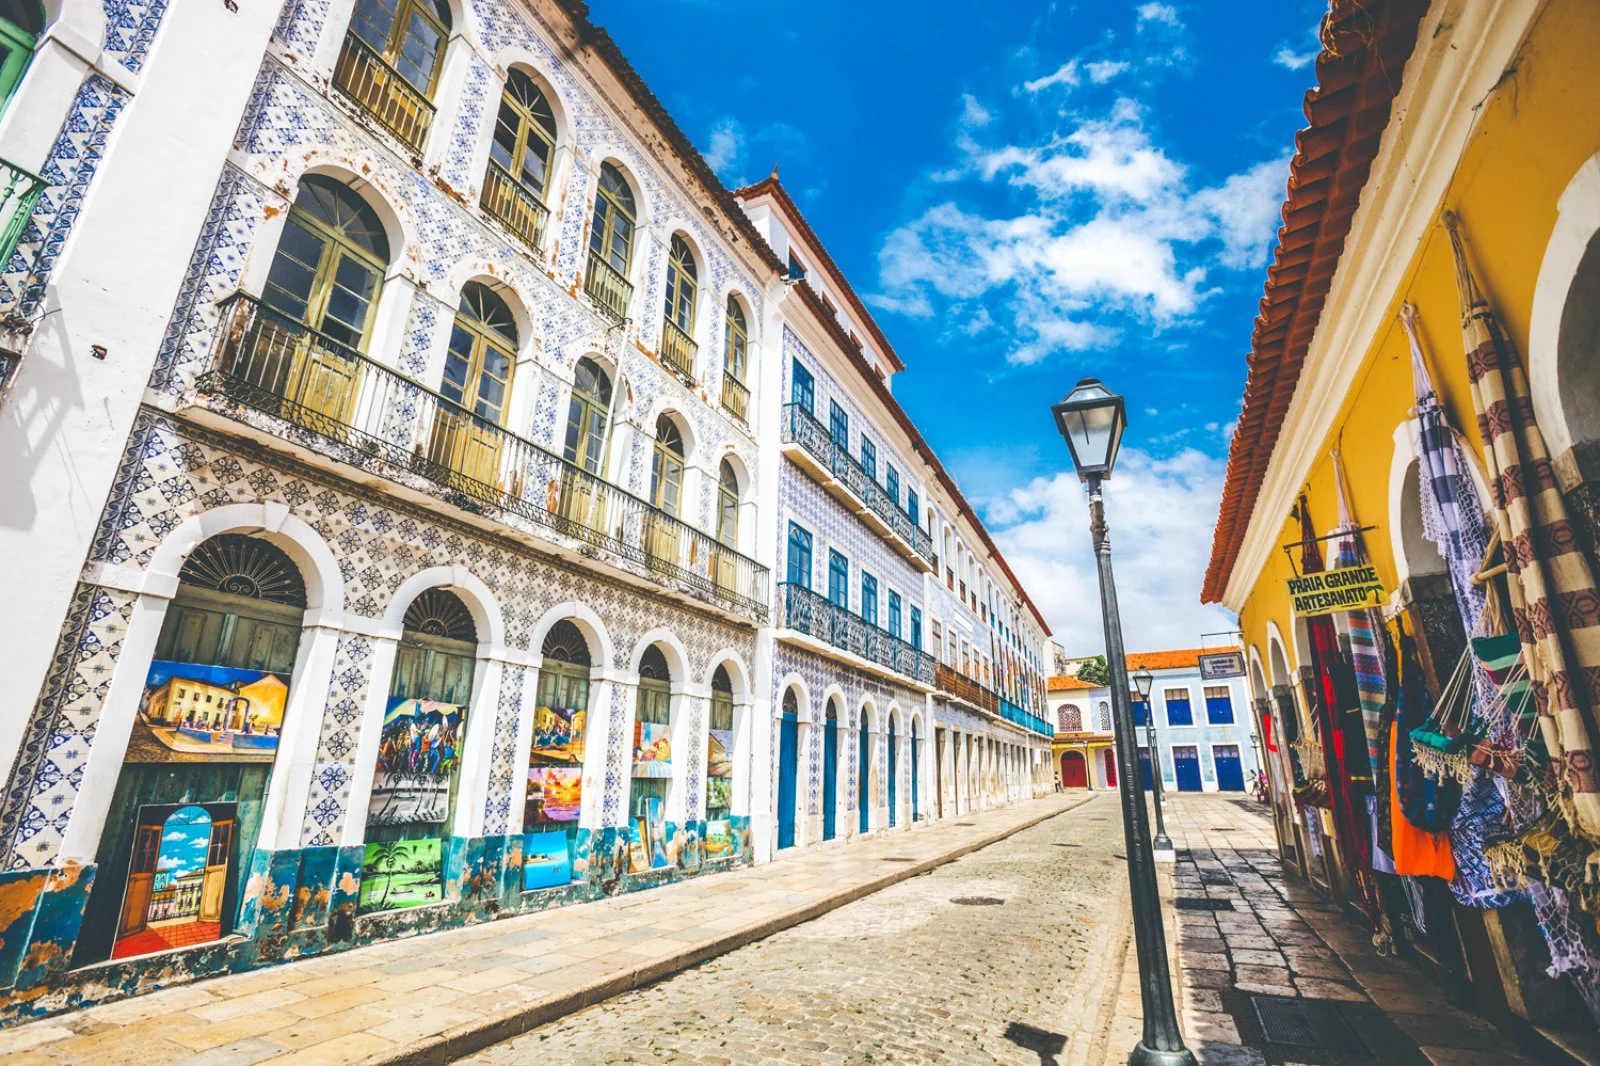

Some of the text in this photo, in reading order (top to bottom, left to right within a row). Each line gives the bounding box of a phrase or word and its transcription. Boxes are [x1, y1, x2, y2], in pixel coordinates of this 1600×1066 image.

[1287, 567, 1379, 595] PRAIA GRANDE
[1295, 587, 1368, 611] ARTESANATO
